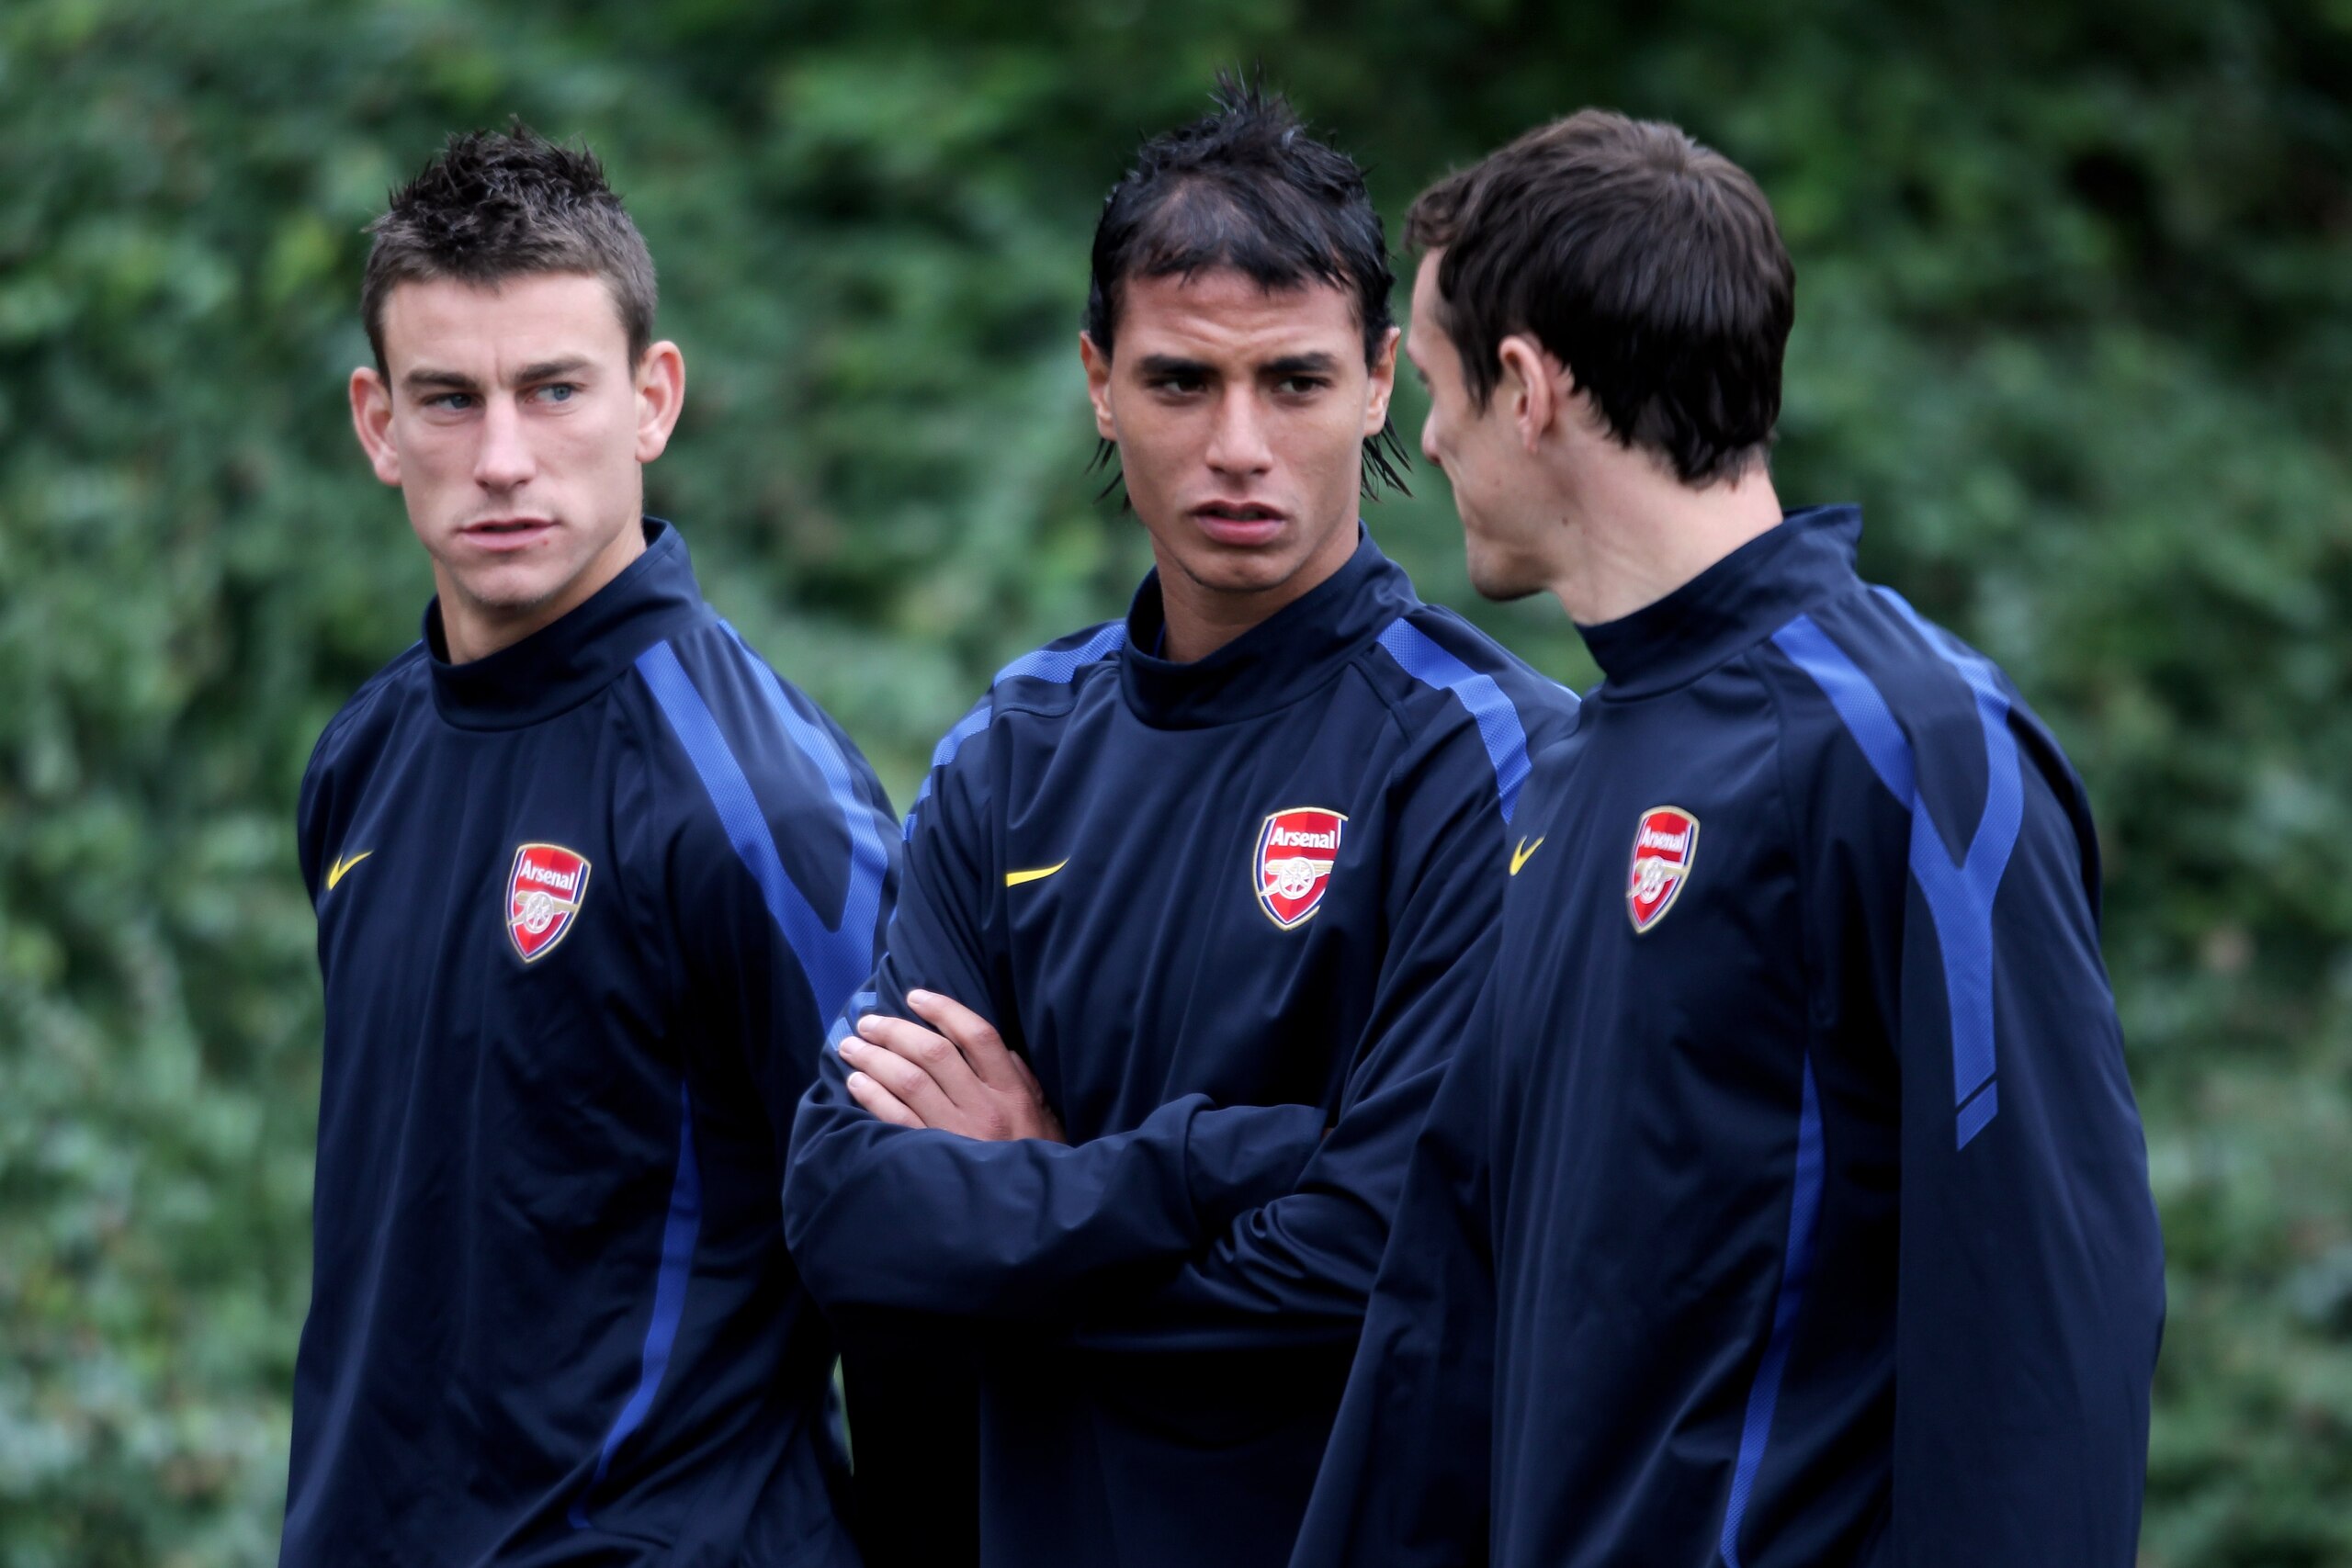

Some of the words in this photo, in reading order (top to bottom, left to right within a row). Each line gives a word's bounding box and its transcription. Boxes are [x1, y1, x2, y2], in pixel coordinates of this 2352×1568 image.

[1272, 827, 1336, 850] Arsenal
[1642, 828, 1685, 852] Arsenal
[521, 860, 575, 890] Arsenal
